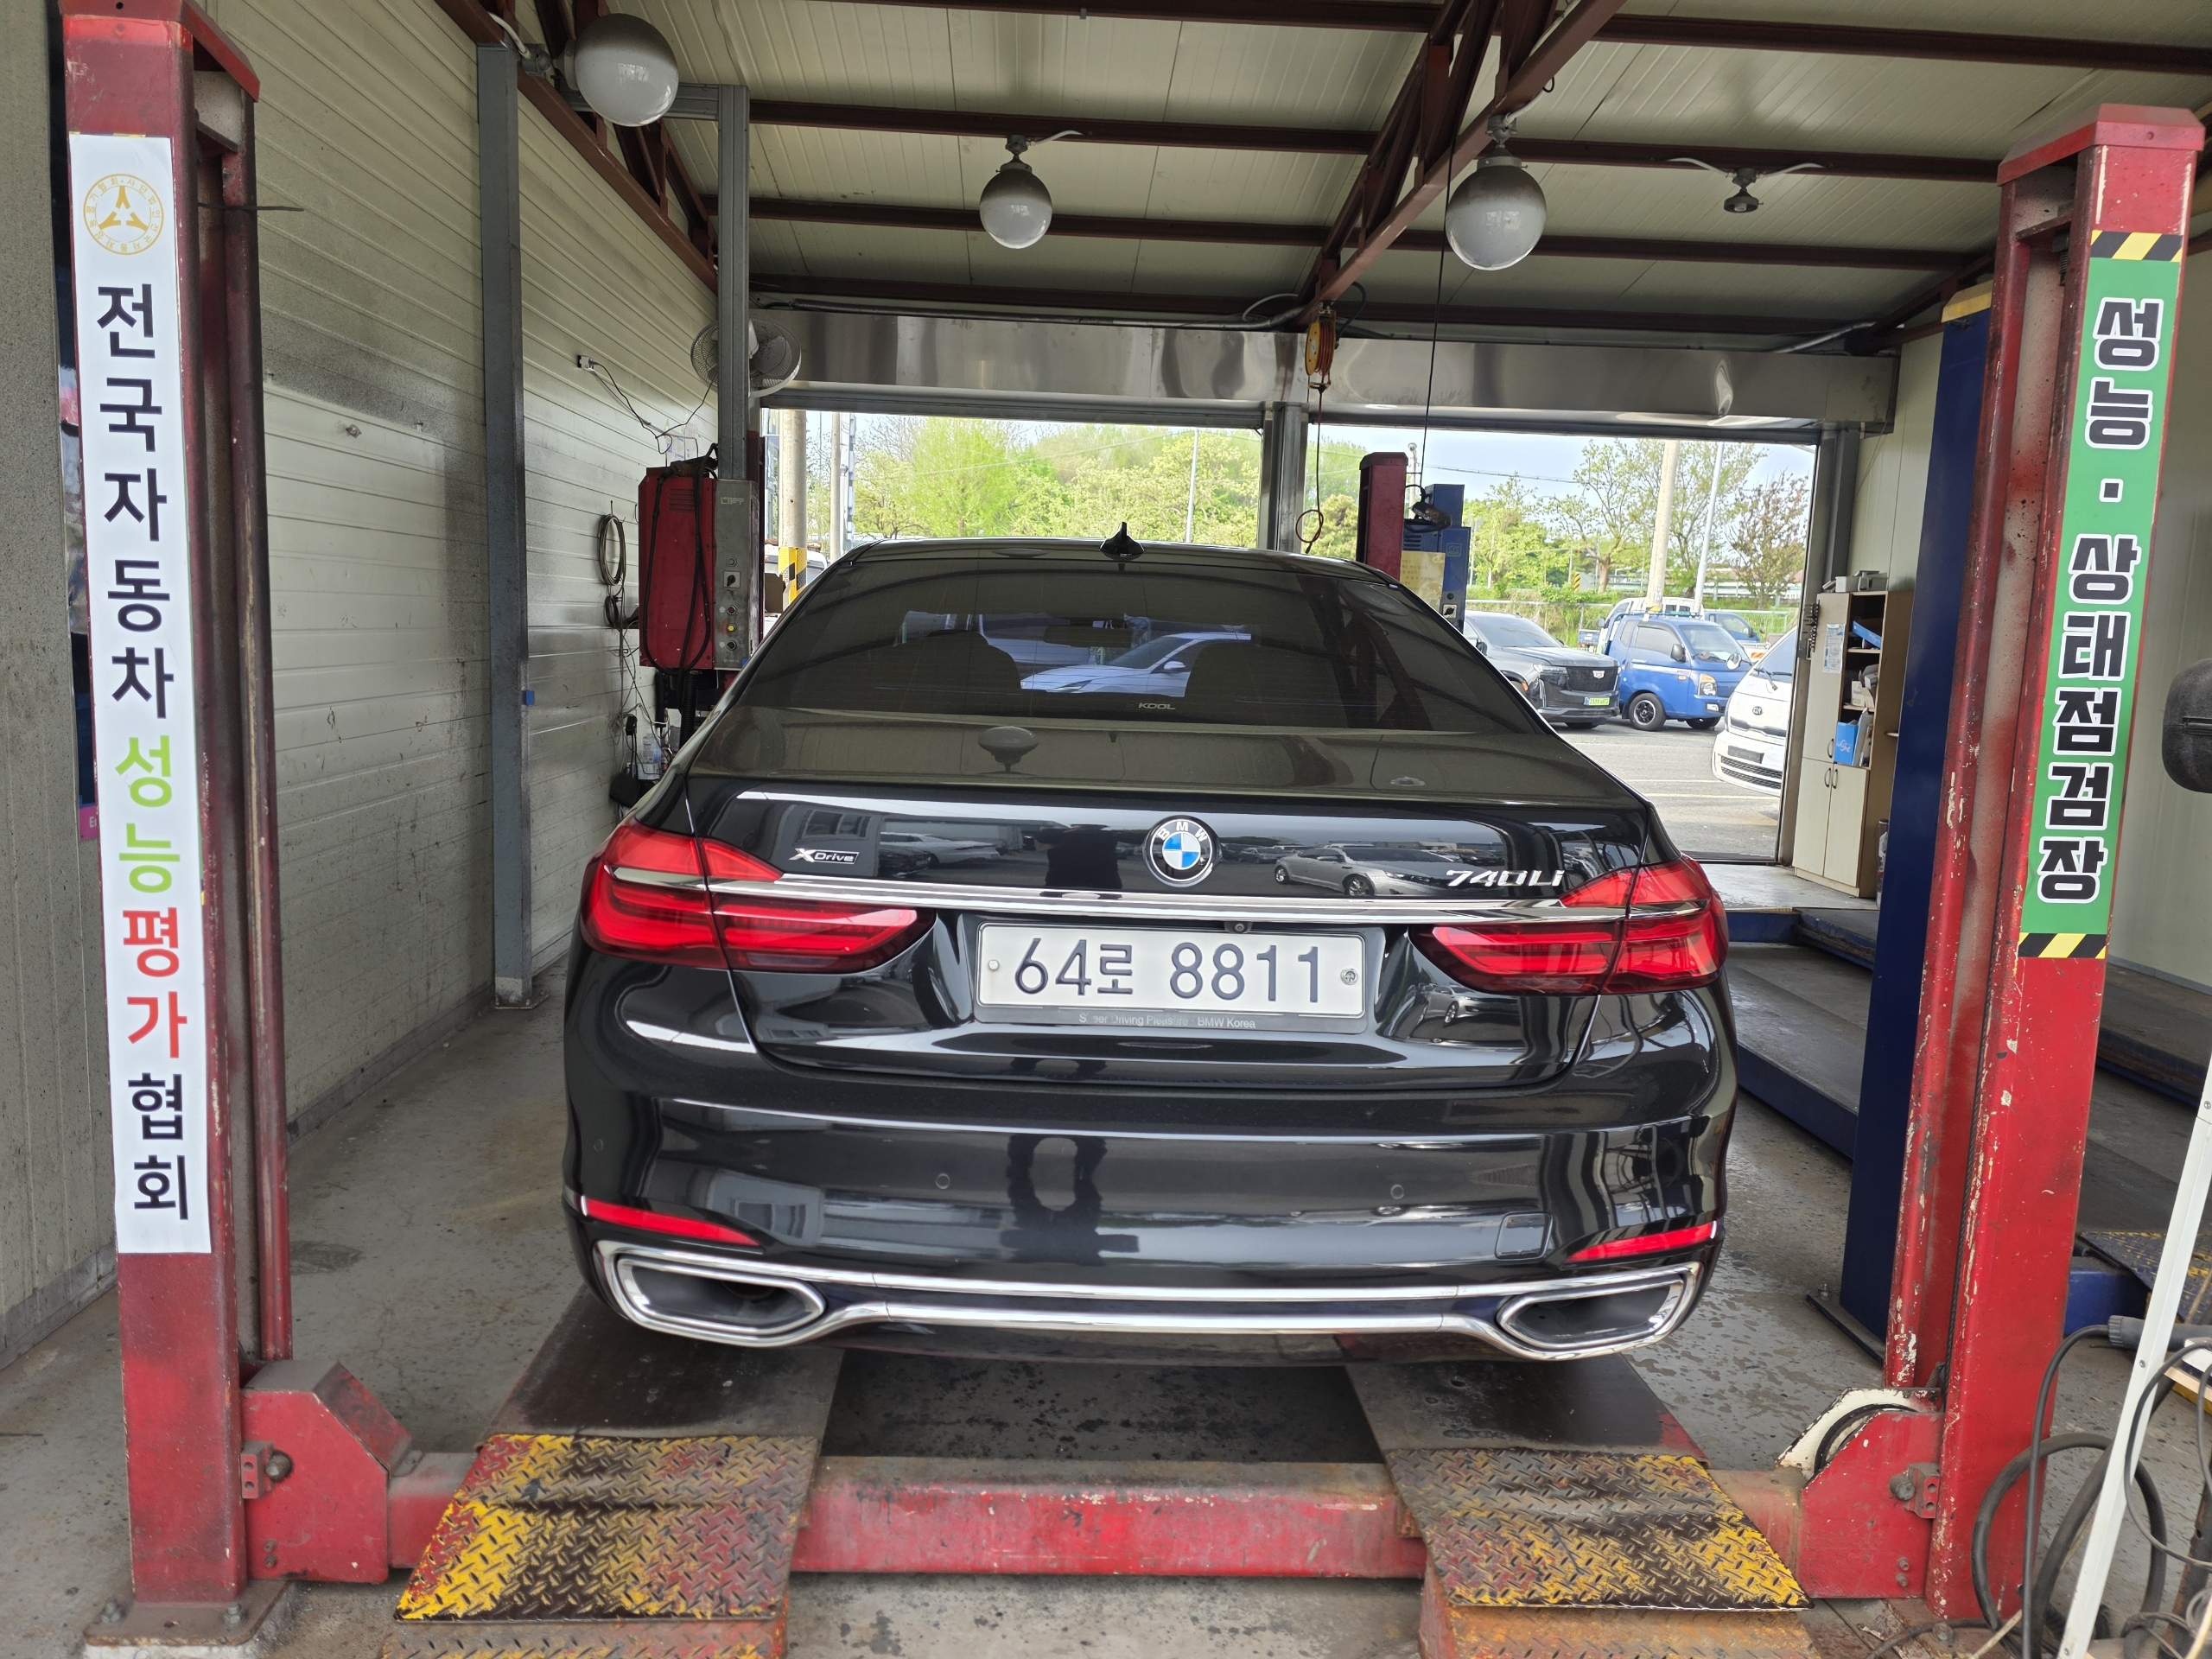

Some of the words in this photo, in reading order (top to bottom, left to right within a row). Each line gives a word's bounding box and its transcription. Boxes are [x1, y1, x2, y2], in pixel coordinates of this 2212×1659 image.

[1156, 821, 1208, 842] BMW
[1446, 869, 1565, 887] 740Li
[1014, 938, 1134, 996] 64로
[1169, 942, 1319, 1003] 8811
[1198, 1016, 1224, 1027] BMW
[1226, 1018, 1256, 1029] Korea
